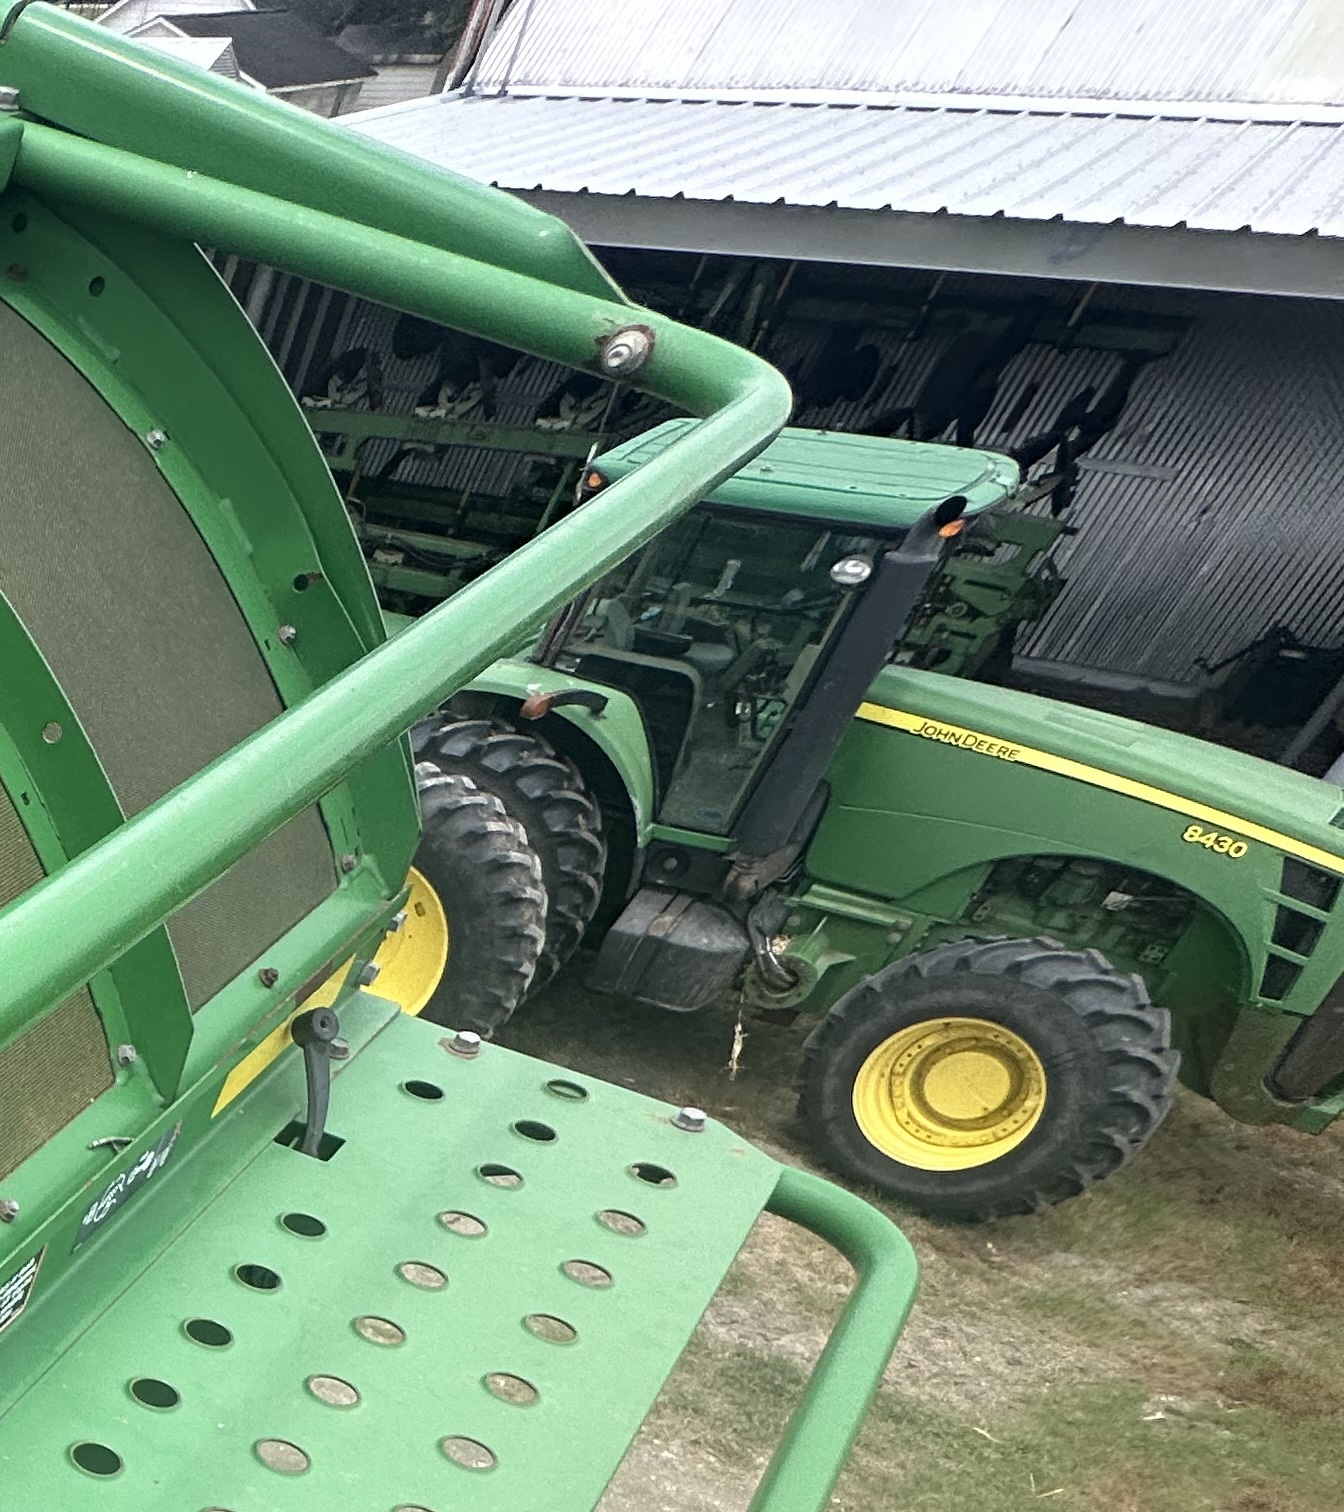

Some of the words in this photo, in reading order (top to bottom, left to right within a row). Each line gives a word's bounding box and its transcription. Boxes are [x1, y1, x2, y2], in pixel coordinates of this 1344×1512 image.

[913, 721, 963, 744] JOHN
[962, 734, 1021, 759] DEERE
[1183, 825, 1248, 858] 8430
